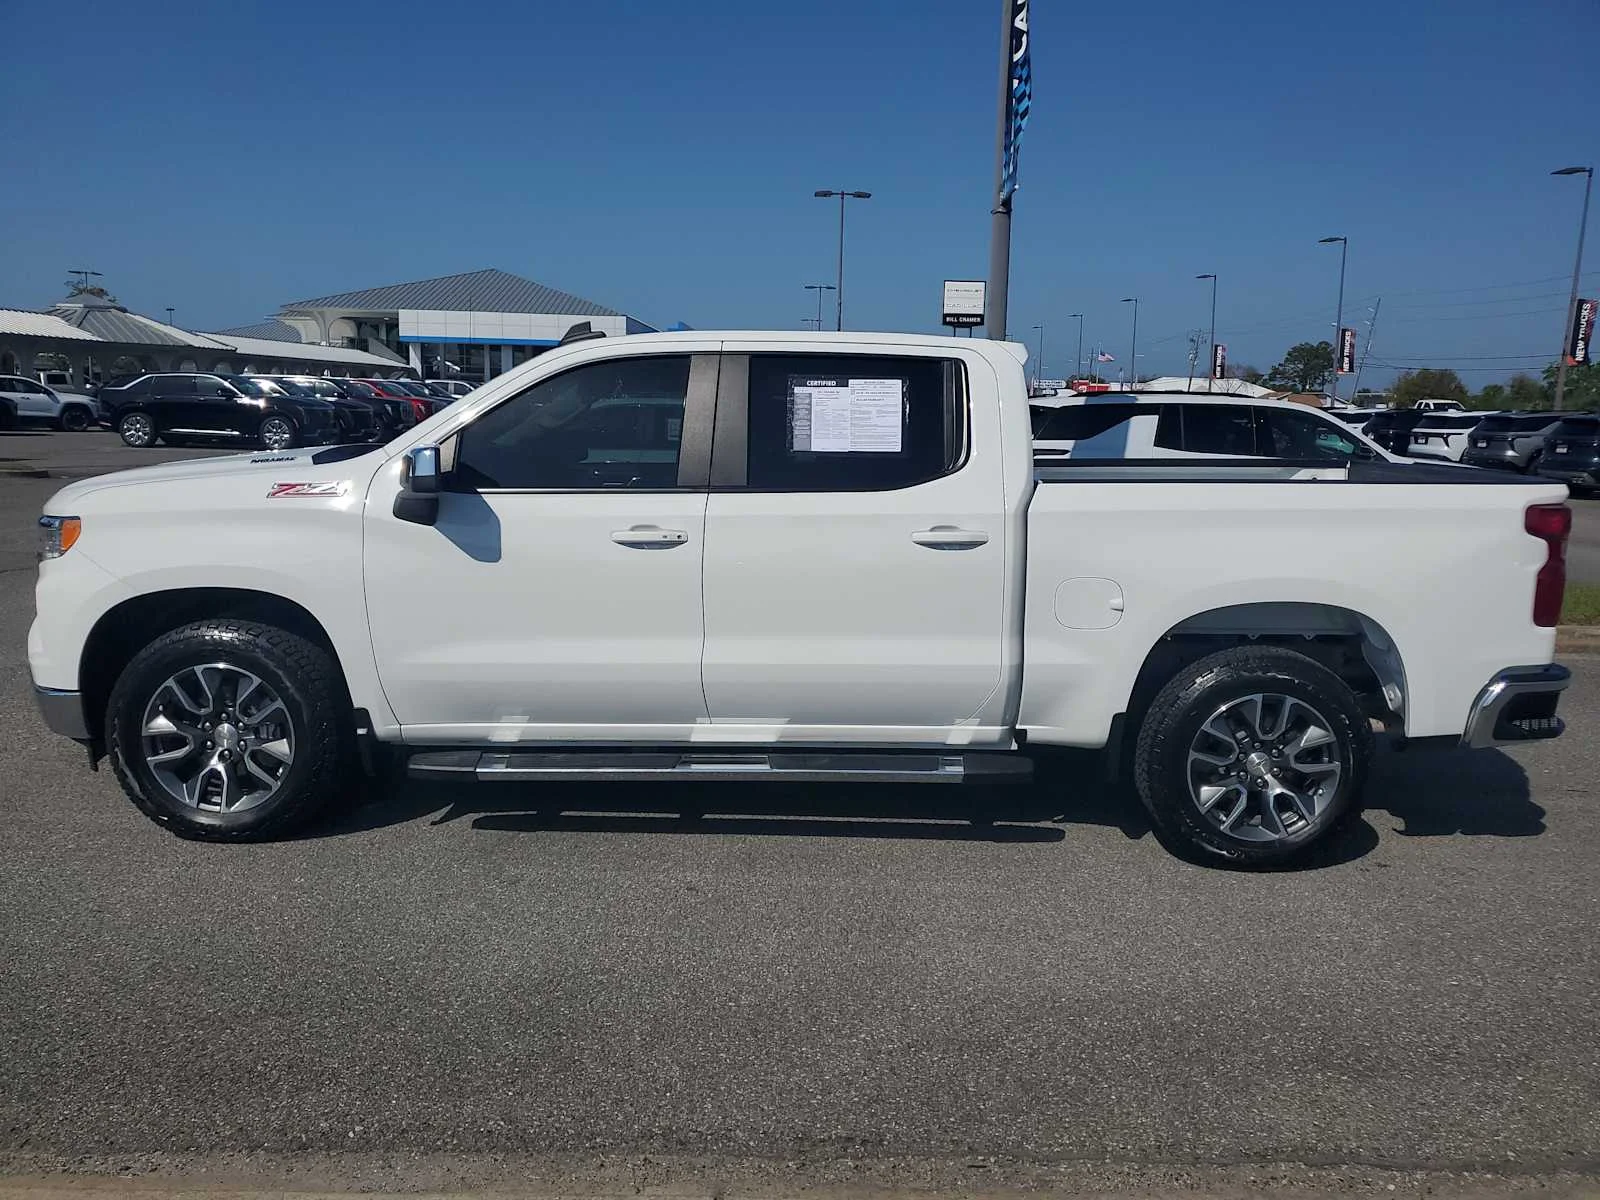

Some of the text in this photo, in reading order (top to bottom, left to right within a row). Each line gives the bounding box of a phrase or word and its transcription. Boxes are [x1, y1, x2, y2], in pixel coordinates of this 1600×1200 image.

[1013, 0, 1028, 62] CA
[1575, 303, 1591, 361] NEW TRUCKS
